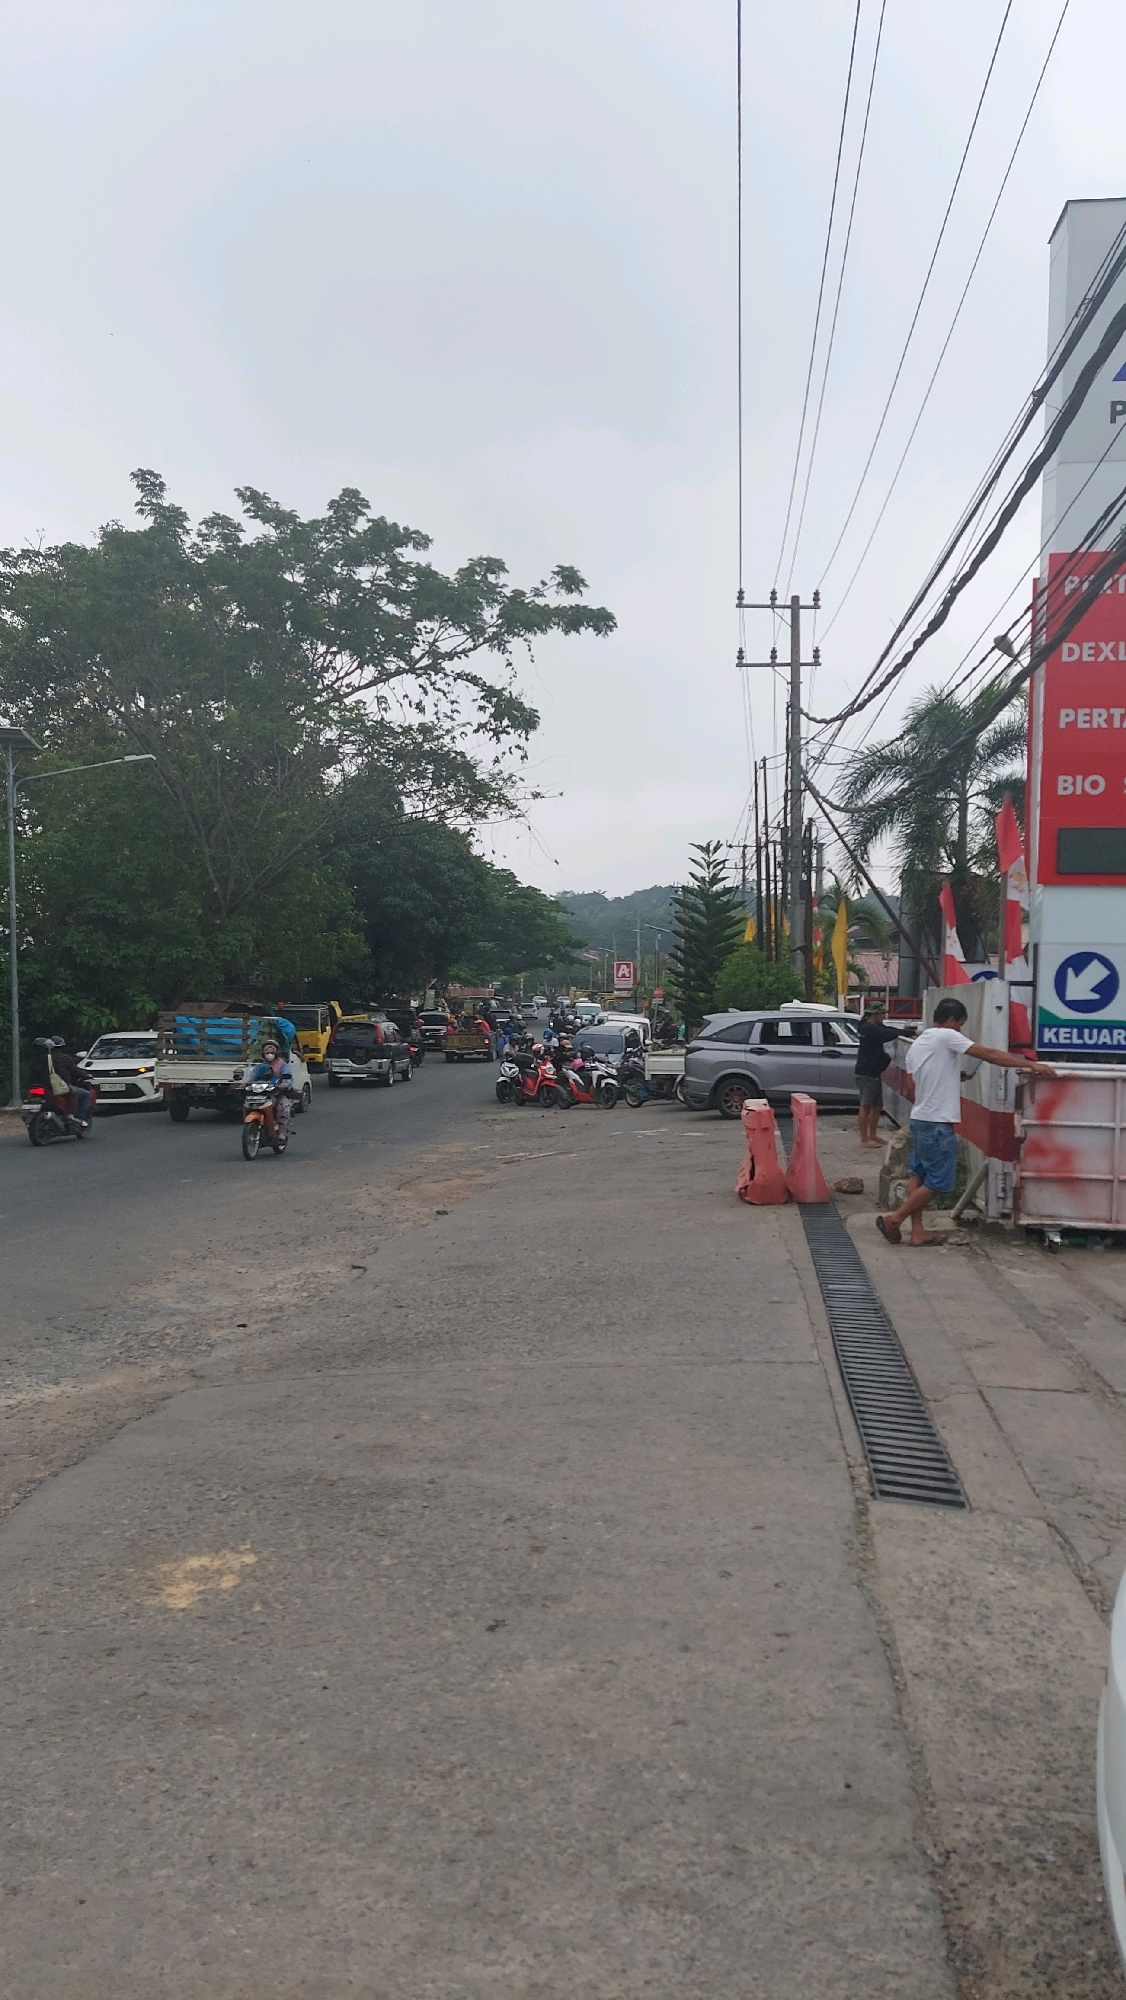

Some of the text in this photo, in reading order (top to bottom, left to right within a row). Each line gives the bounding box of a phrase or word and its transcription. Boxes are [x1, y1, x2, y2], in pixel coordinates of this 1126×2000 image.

[1059, 708, 1126, 729] PERT
[1057, 774, 1106, 796] BIO
[1043, 1027, 1126, 1046] KELUAR
